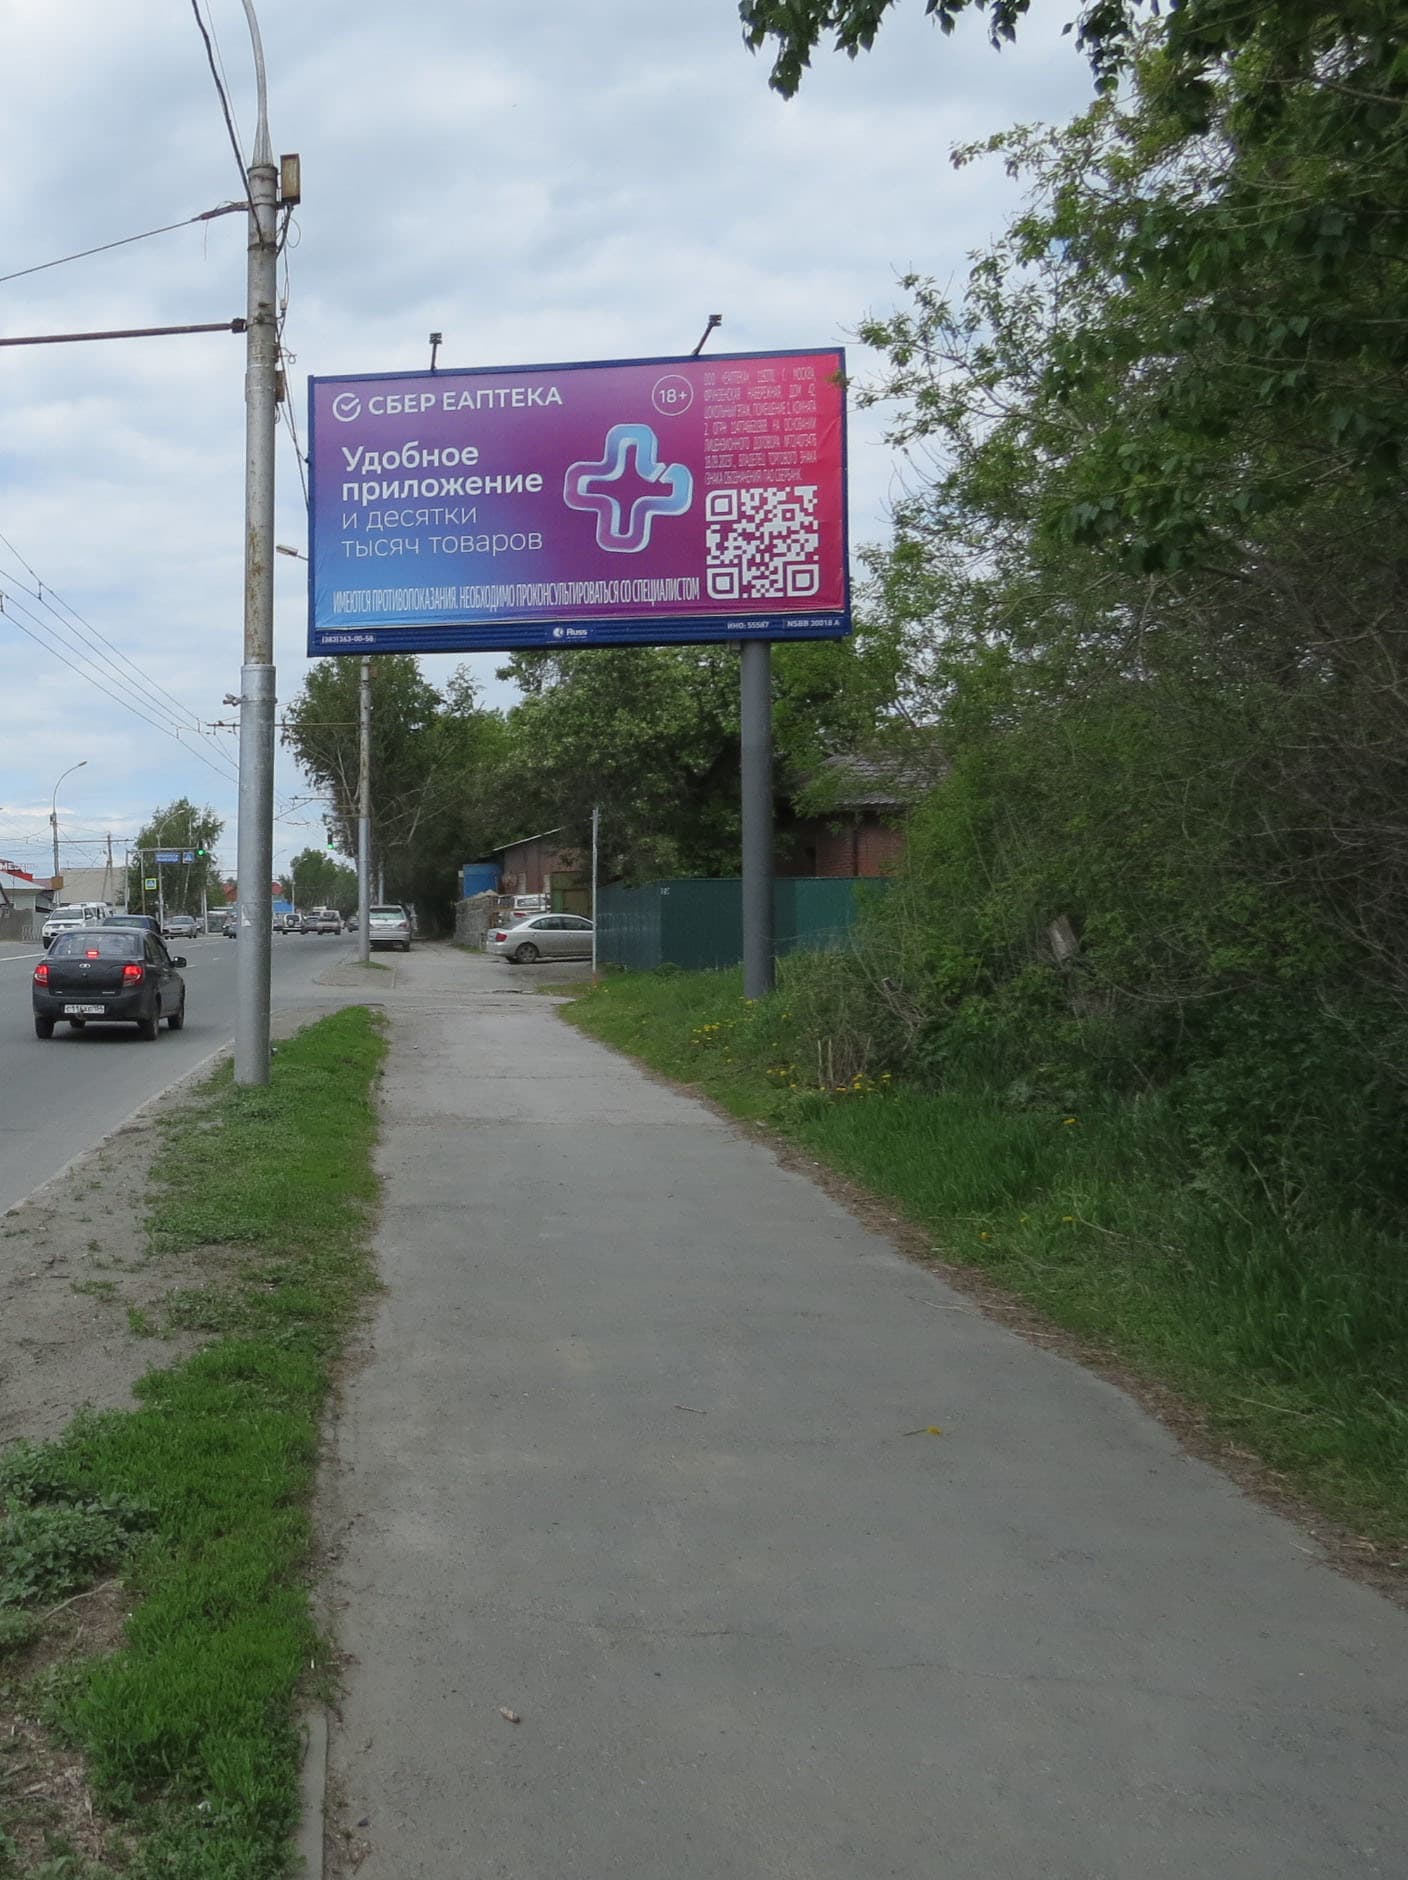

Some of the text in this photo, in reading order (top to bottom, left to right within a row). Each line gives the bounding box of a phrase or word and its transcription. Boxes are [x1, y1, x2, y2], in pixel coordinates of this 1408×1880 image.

[368, 386, 563, 415] СБЕР ЕАПТЕКА
[658, 388, 688, 404] 18+
[342, 440, 479, 475] Удобное
[342, 472, 543, 507] приложение
[342, 506, 478, 532] и десятки
[341, 531, 543, 558] тысяч товаров
[333, 590, 372, 614] ИМЕЮТСЯ
[460, 583, 514, 612] НЕОБХОДИМО
[517, 580, 619, 607] ПРОКОНСУЛЬТИРОВАТЬСЯ
[620, 579, 632, 602] СО
[633, 577, 700, 606] СПЕЦИАЛИСТОМ
